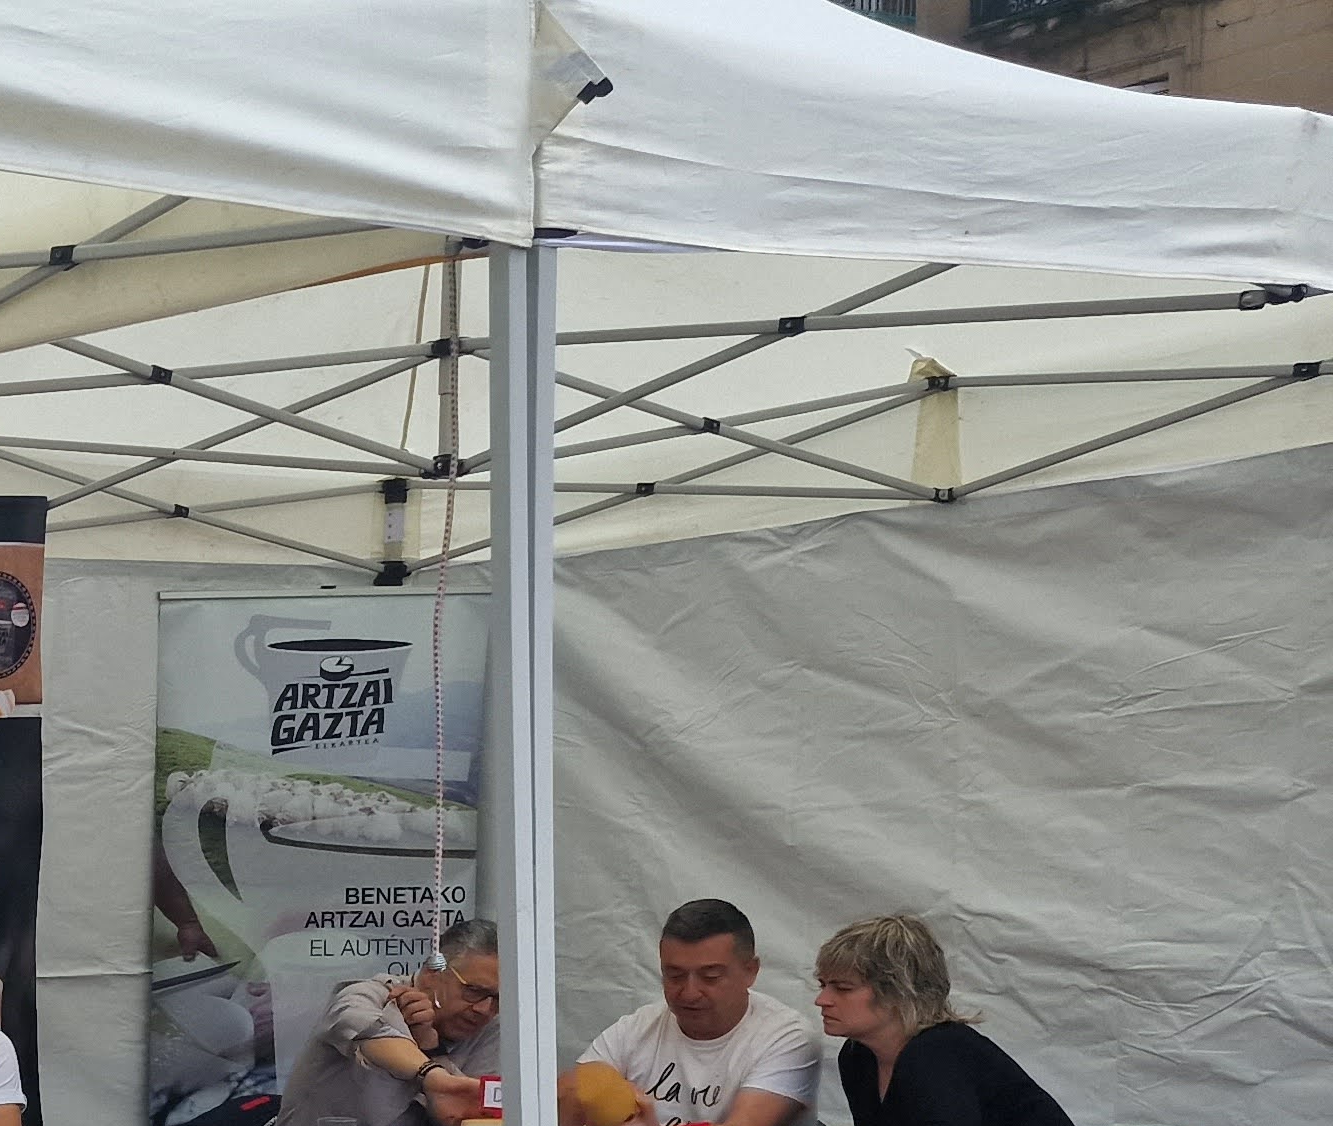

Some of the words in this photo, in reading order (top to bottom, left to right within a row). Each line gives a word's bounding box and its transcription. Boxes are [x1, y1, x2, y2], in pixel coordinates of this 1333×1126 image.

[273, 678, 393, 713] ARTZAI
[271, 707, 384, 746] GAZTA
[315, 738, 380, 750] ELKARTEA
[345, 886, 465, 904] BENETAKO
[304, 911, 384, 929] ARTZAI
[310, 939, 334, 957] EL
[645, 1062, 680, 1103] la
